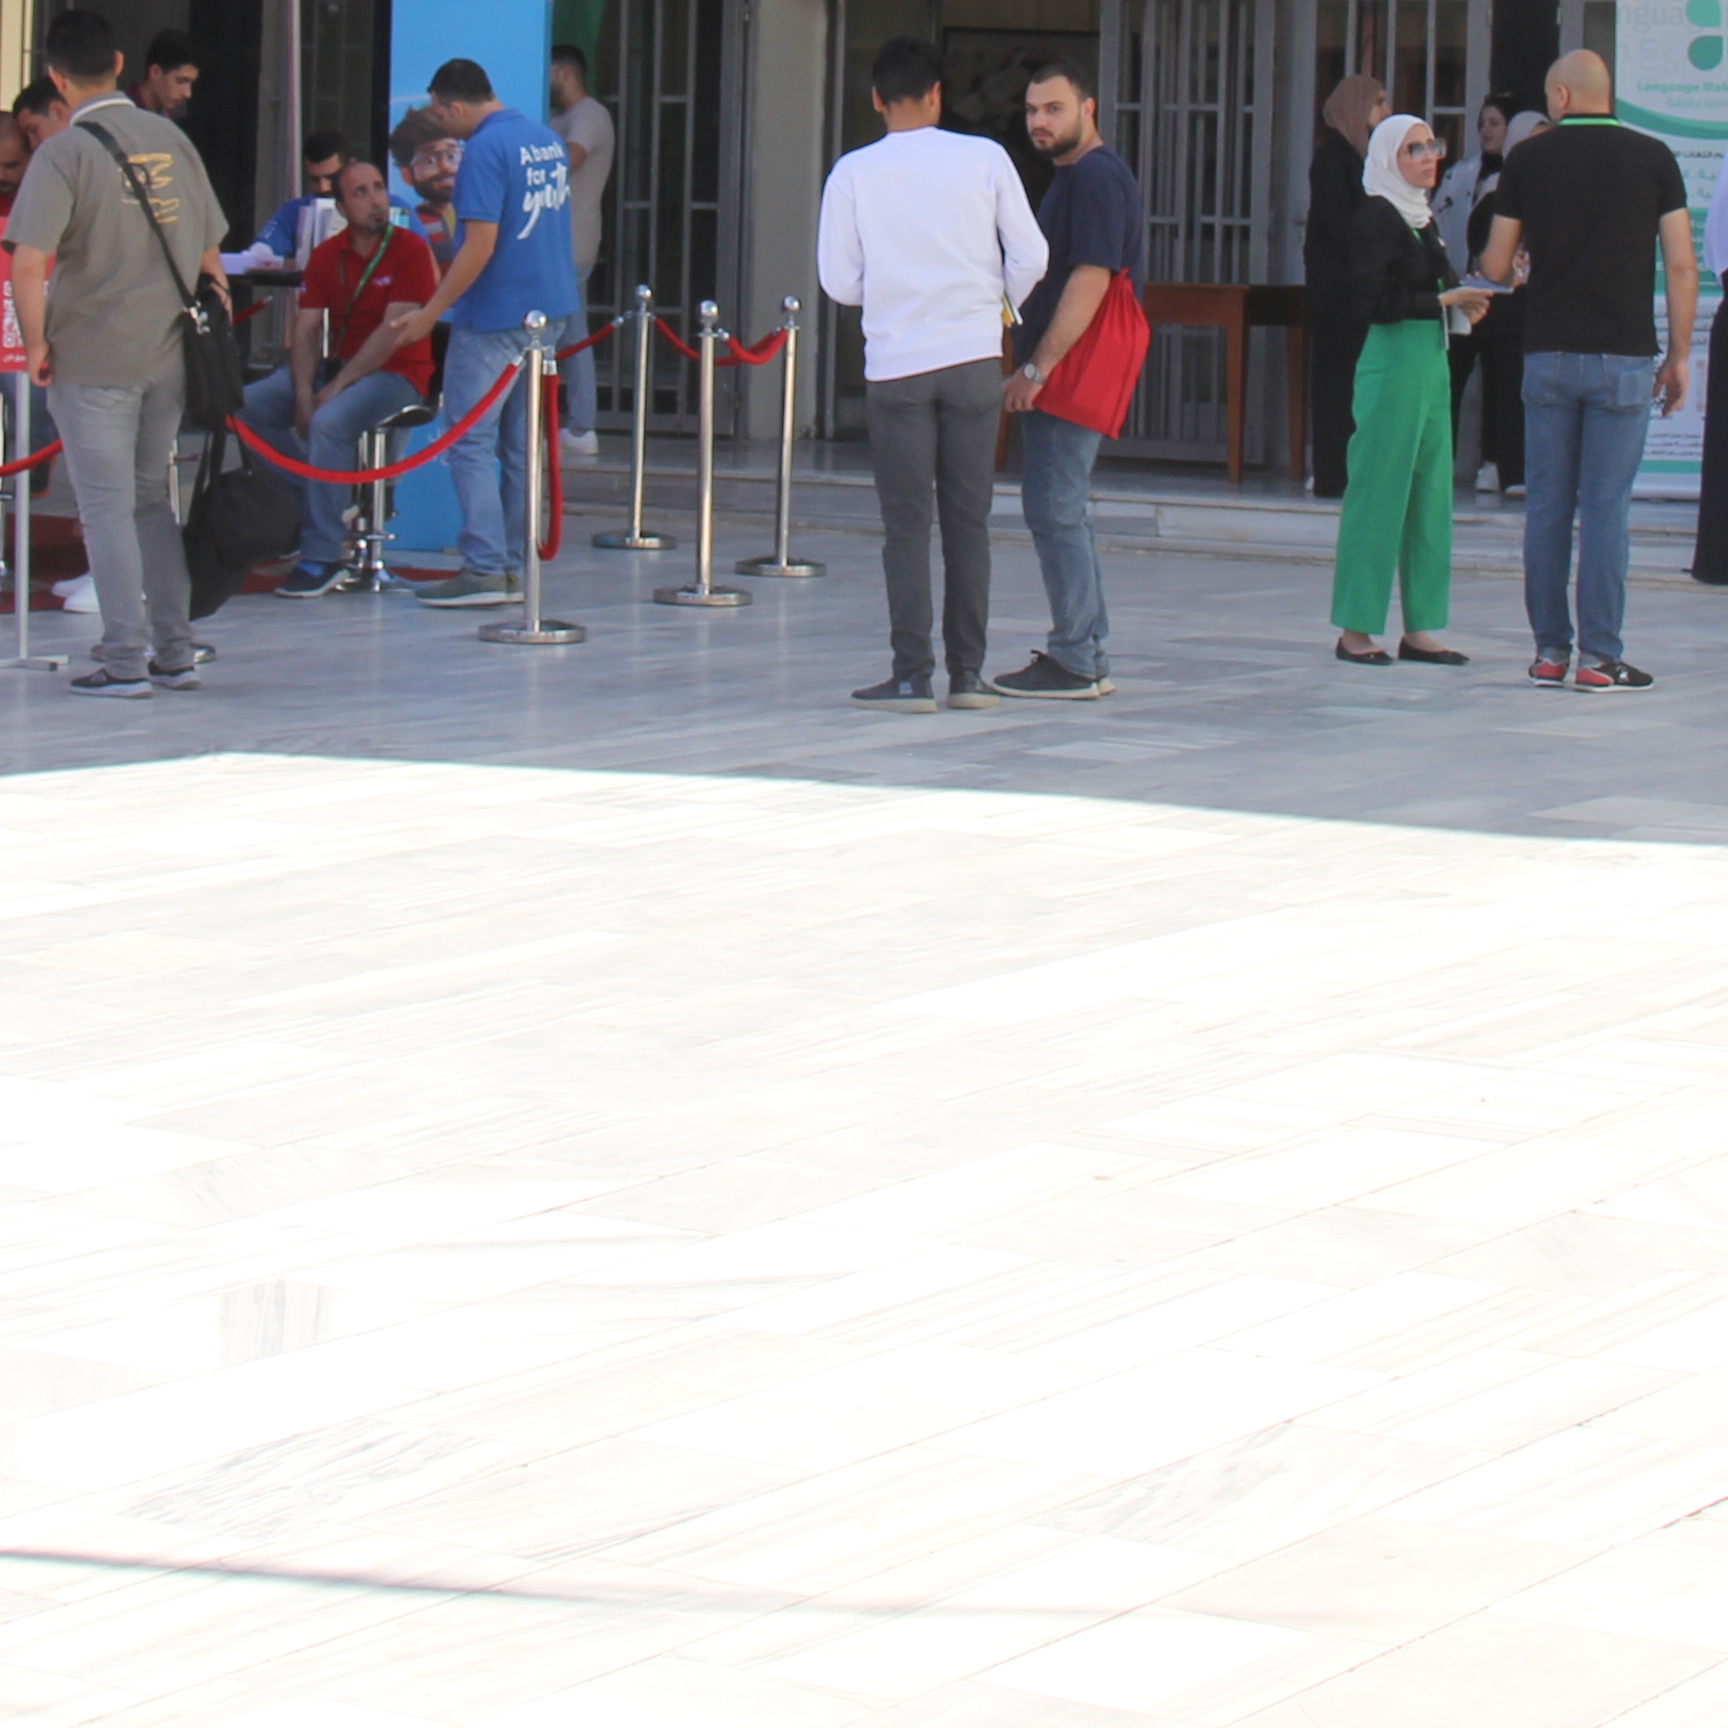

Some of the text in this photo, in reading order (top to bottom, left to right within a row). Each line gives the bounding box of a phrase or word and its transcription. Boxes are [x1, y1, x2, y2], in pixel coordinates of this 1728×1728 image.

[1637, 82, 1700, 95] Language
[520, 141, 565, 166] A bank
[526, 167, 546, 186] for
